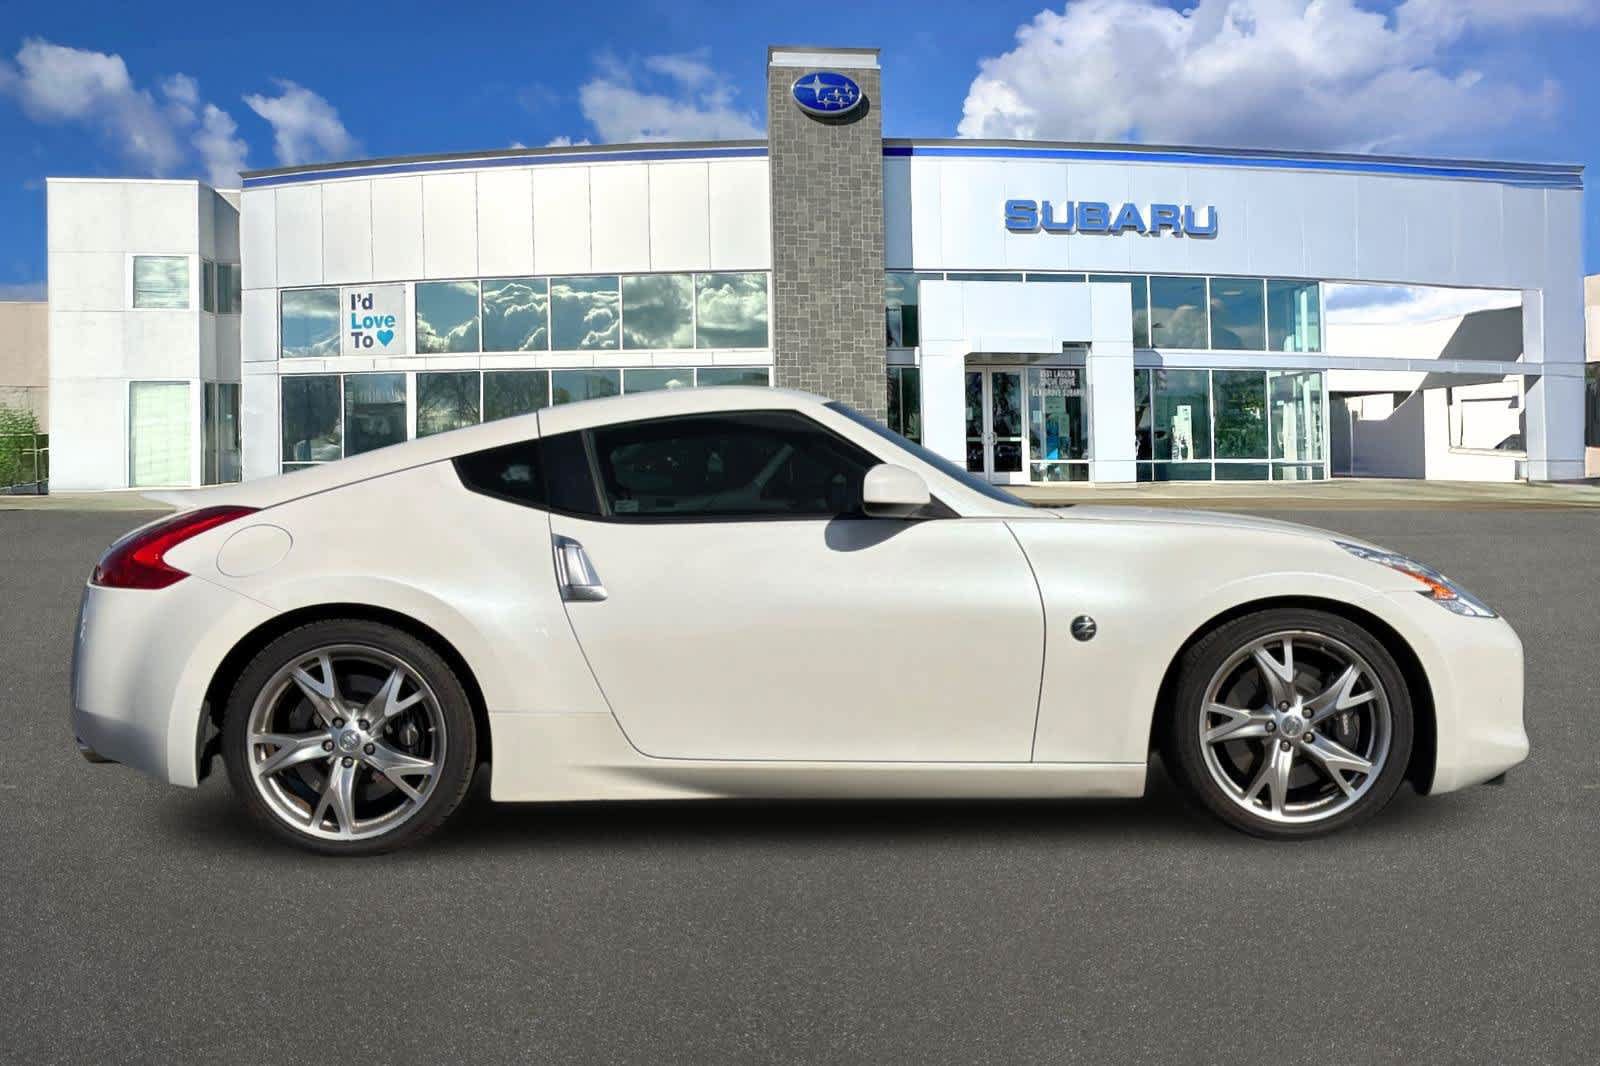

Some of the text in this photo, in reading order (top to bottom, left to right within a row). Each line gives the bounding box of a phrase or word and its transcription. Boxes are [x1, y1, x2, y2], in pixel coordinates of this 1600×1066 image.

[1005, 199, 1217, 238] SUBARU
[351, 313, 396, 329] Love
[351, 331, 374, 348] To
